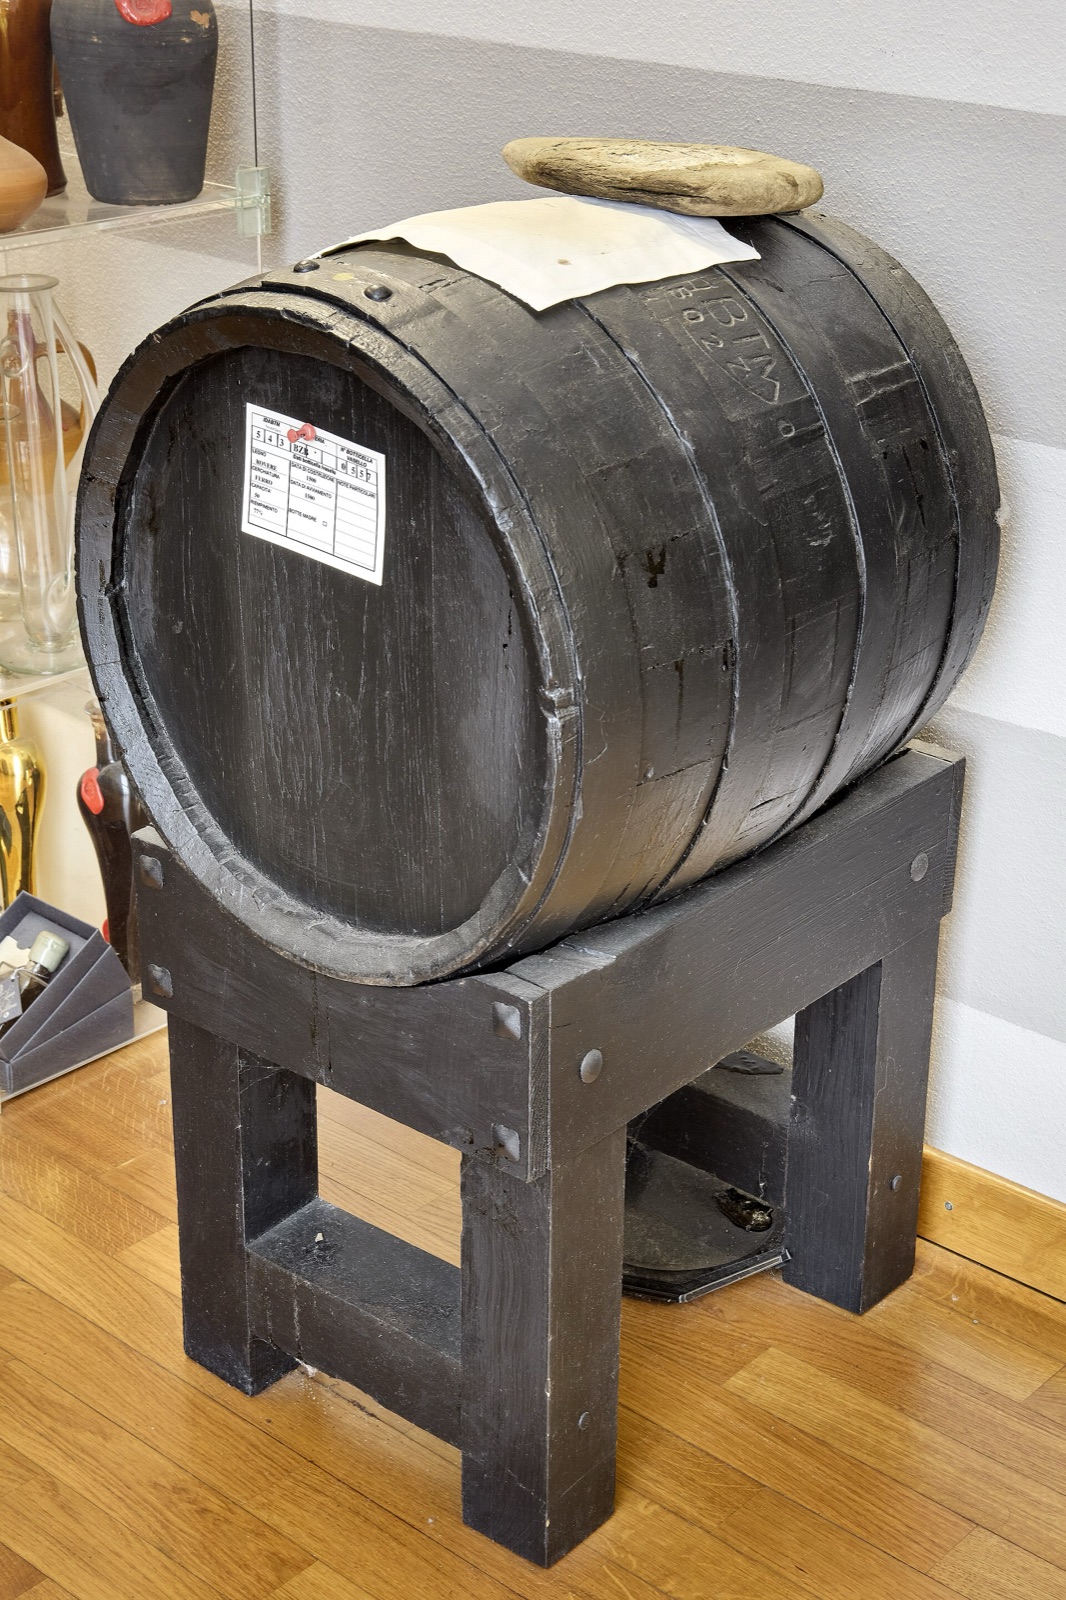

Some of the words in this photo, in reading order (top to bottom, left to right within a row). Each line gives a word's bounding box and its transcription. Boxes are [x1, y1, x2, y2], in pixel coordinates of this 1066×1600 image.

[252, 448, 267, 457] LEGNO
[346, 448, 373, 464] BOTTICELLA
[252, 465, 281, 479] CERCHIATURA
[291, 461, 302, 470] DATA
[307, 467, 335, 483] COSTRUZIONE
[290, 479, 302, 487] DATA
[306, 485, 332, 499] AVVIAMENTO
[337, 479, 349, 490] NOTE
[349, 484, 376, 499] PARTICOLARI
[250, 499, 278, 513] RIEMPIMENTO
[288, 507, 302, 517] BOTTE
[302, 512, 317, 522] MADRE
